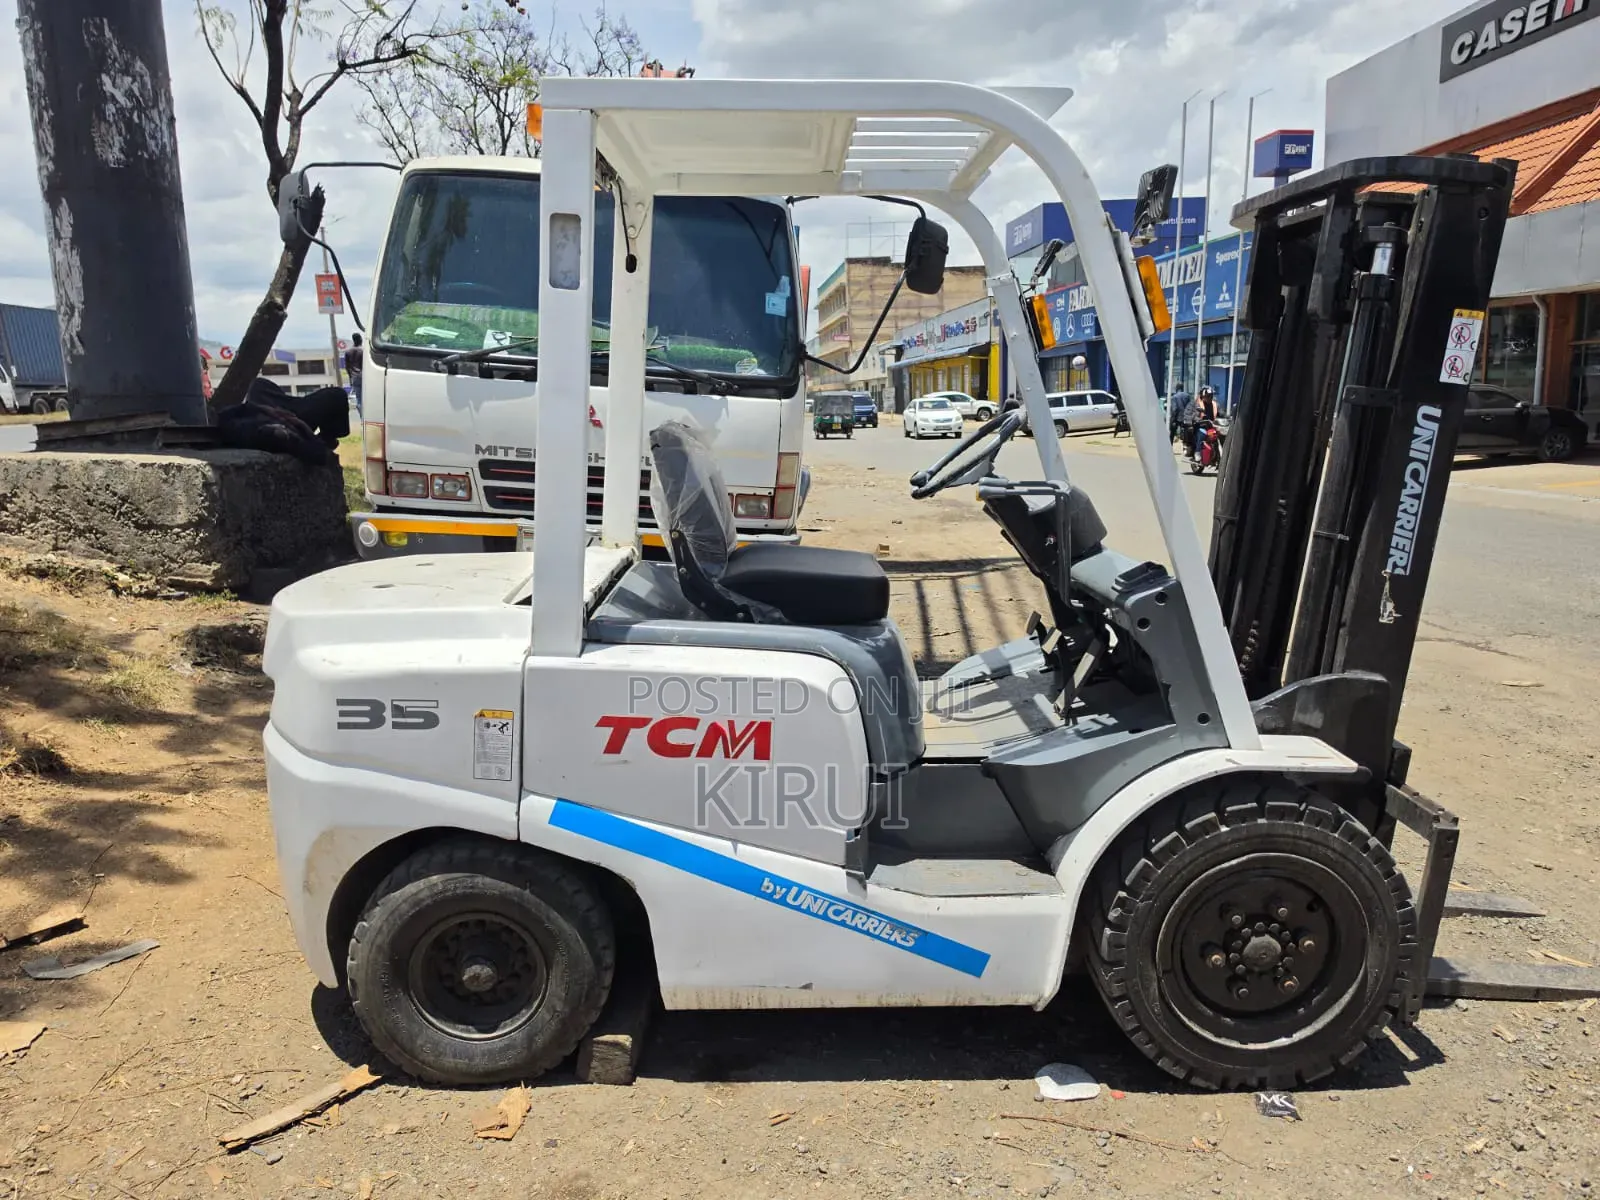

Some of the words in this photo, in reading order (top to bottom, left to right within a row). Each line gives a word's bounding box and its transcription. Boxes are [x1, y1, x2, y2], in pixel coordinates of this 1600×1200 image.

[1450, 0, 1550, 65] CASE
[336, 698, 440, 730] 35
[595, 715, 773, 761] TCM
[760, 877, 787, 900] by
[786, 886, 919, 947] UNICARRIERS
